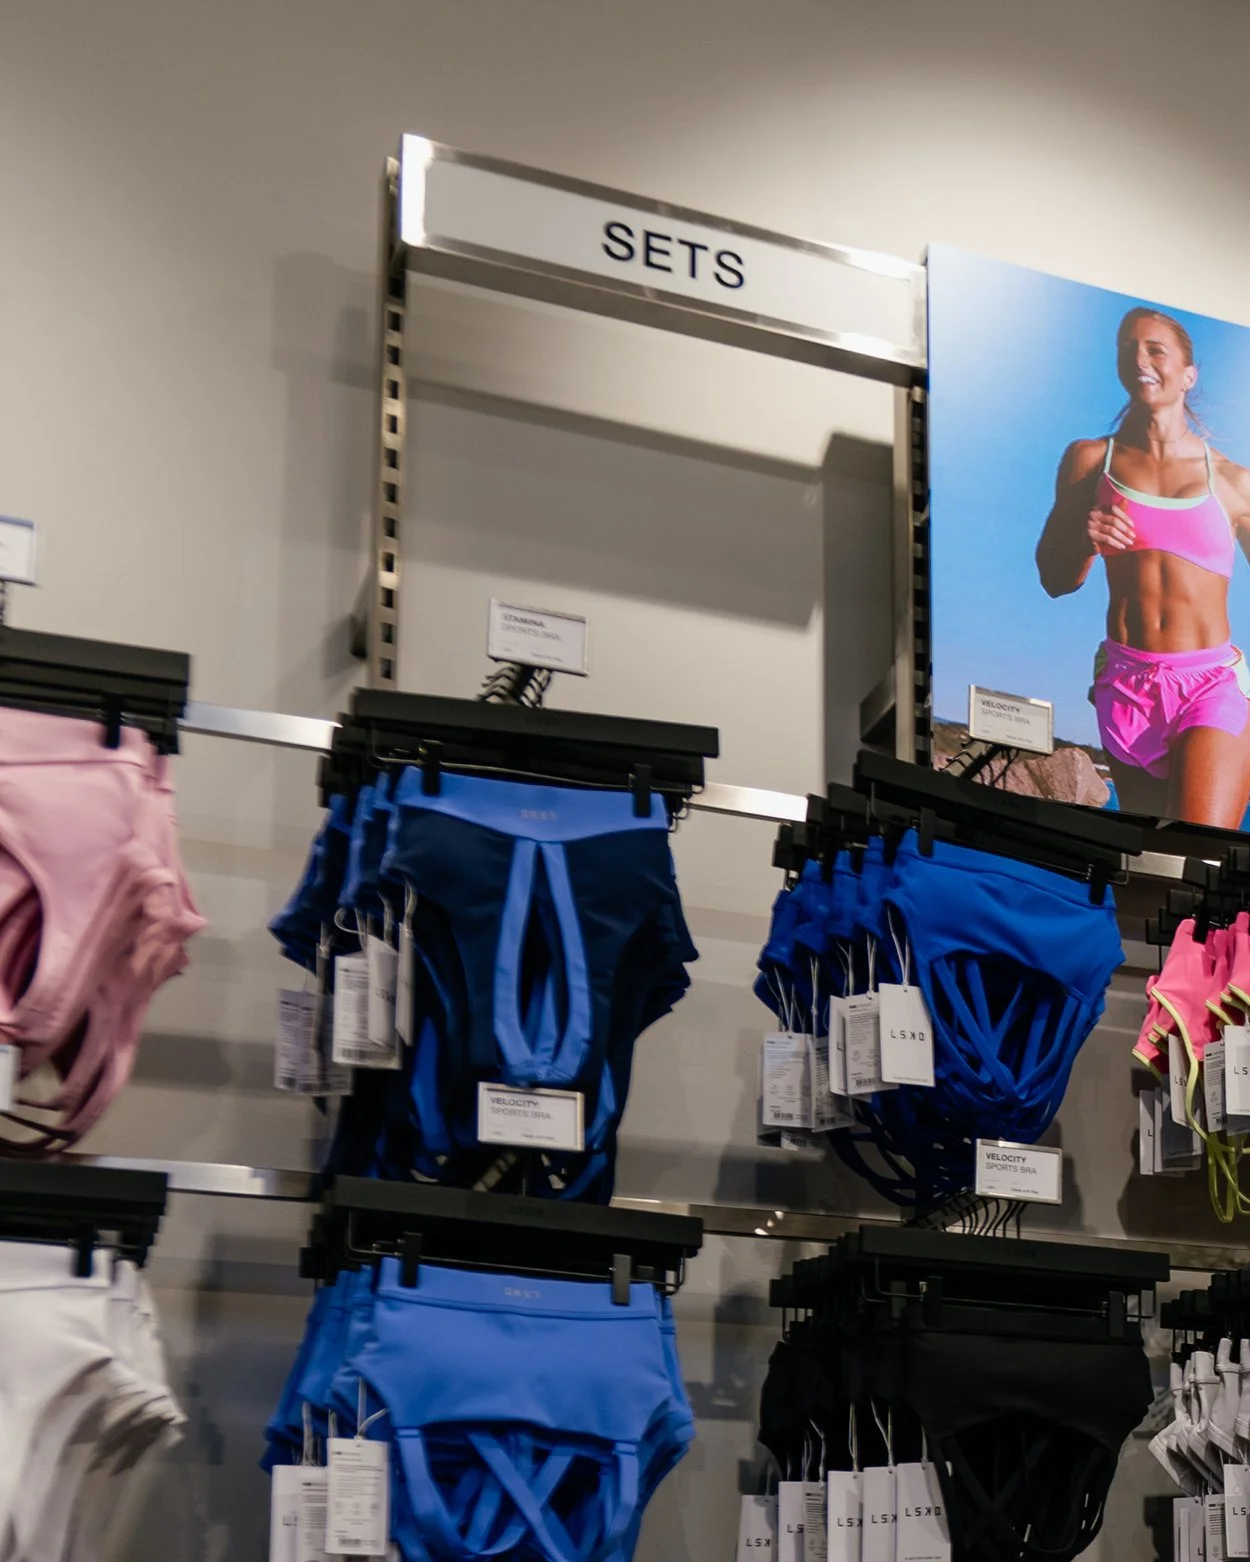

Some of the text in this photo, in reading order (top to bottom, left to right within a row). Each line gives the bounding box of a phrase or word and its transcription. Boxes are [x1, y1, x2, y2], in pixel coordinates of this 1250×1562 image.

[602, 221, 745, 289] SETS
[981, 699, 1022, 713] VELOCITY
[981, 708, 1031, 726] SPORTS BRA
[890, 1030, 925, 1042] LSKD
[490, 1096, 540, 1109] VELOCITY
[490, 1106, 553, 1120] SPORTS BRA
[985, 1152, 1027, 1164] VELOCITY
[985, 1161, 1037, 1175] SPORTS BRA
[905, 1506, 942, 1517] LSKD
[1233, 1506, 1246, 1516] LS
[837, 1518, 862, 1527] LSK
[871, 1514, 897, 1524] LSK
[787, 1524, 804, 1533] LS
[745, 1538, 771, 1547] LSK
